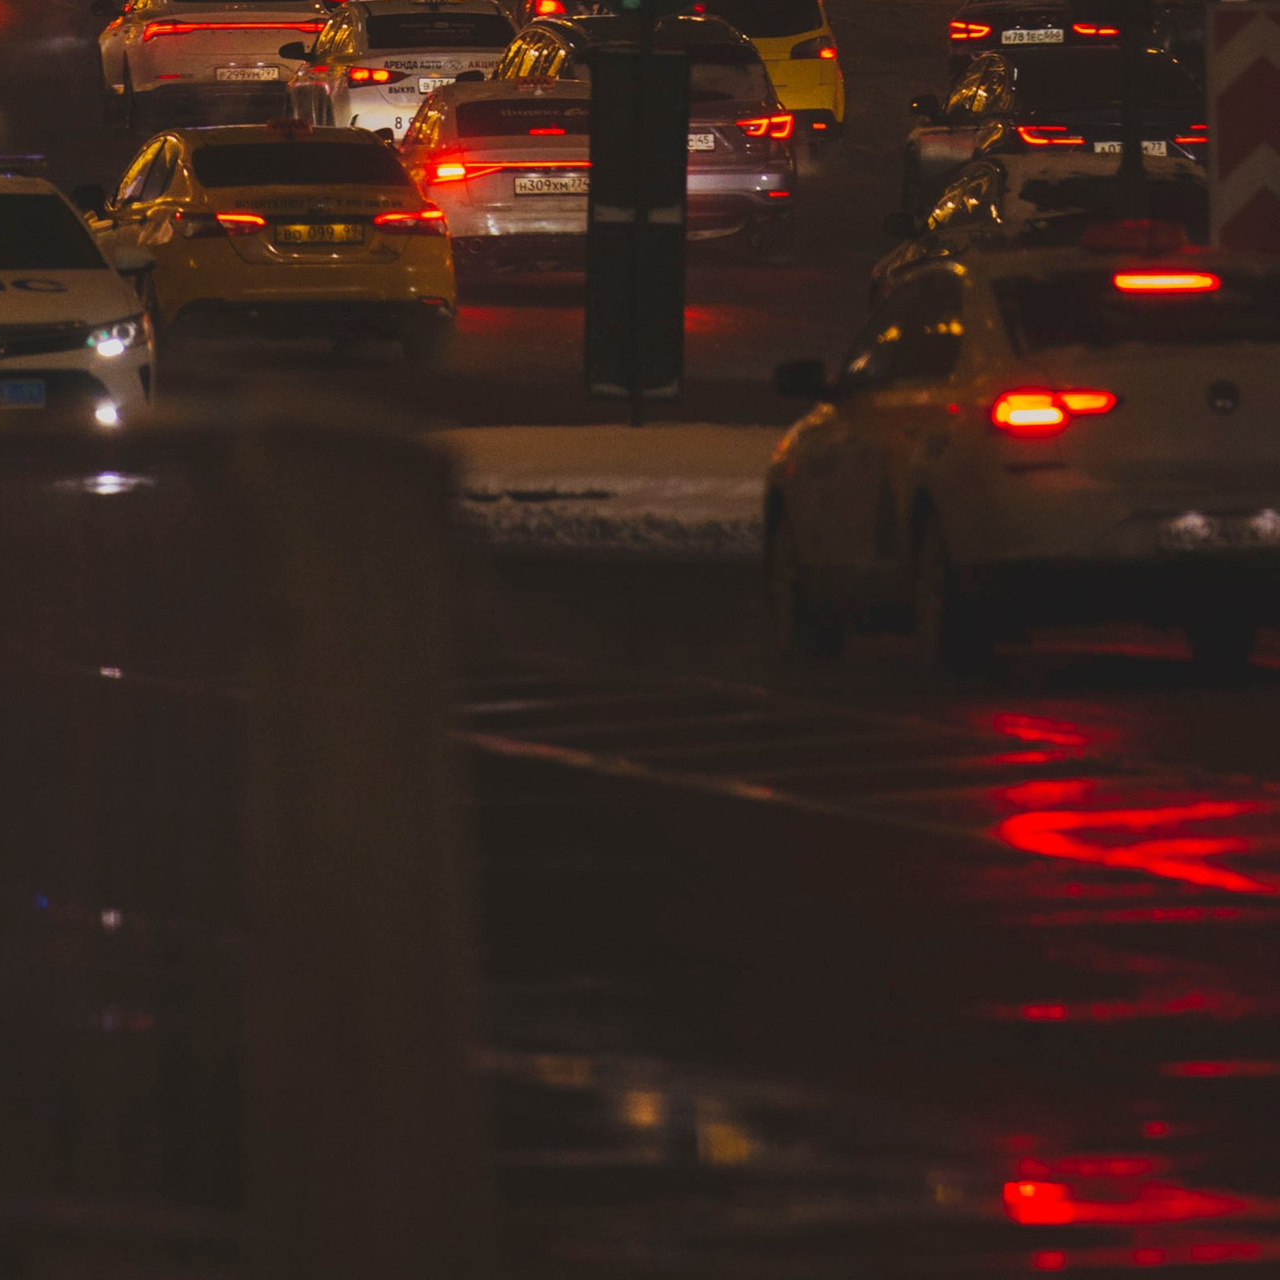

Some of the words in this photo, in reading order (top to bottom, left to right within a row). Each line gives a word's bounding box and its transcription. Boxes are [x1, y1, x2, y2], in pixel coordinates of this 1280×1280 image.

[384, 60, 418, 70] АРЕНДА
[419, 60, 442, 70] АВТО
[388, 86, 415, 94] ВЫКУП
